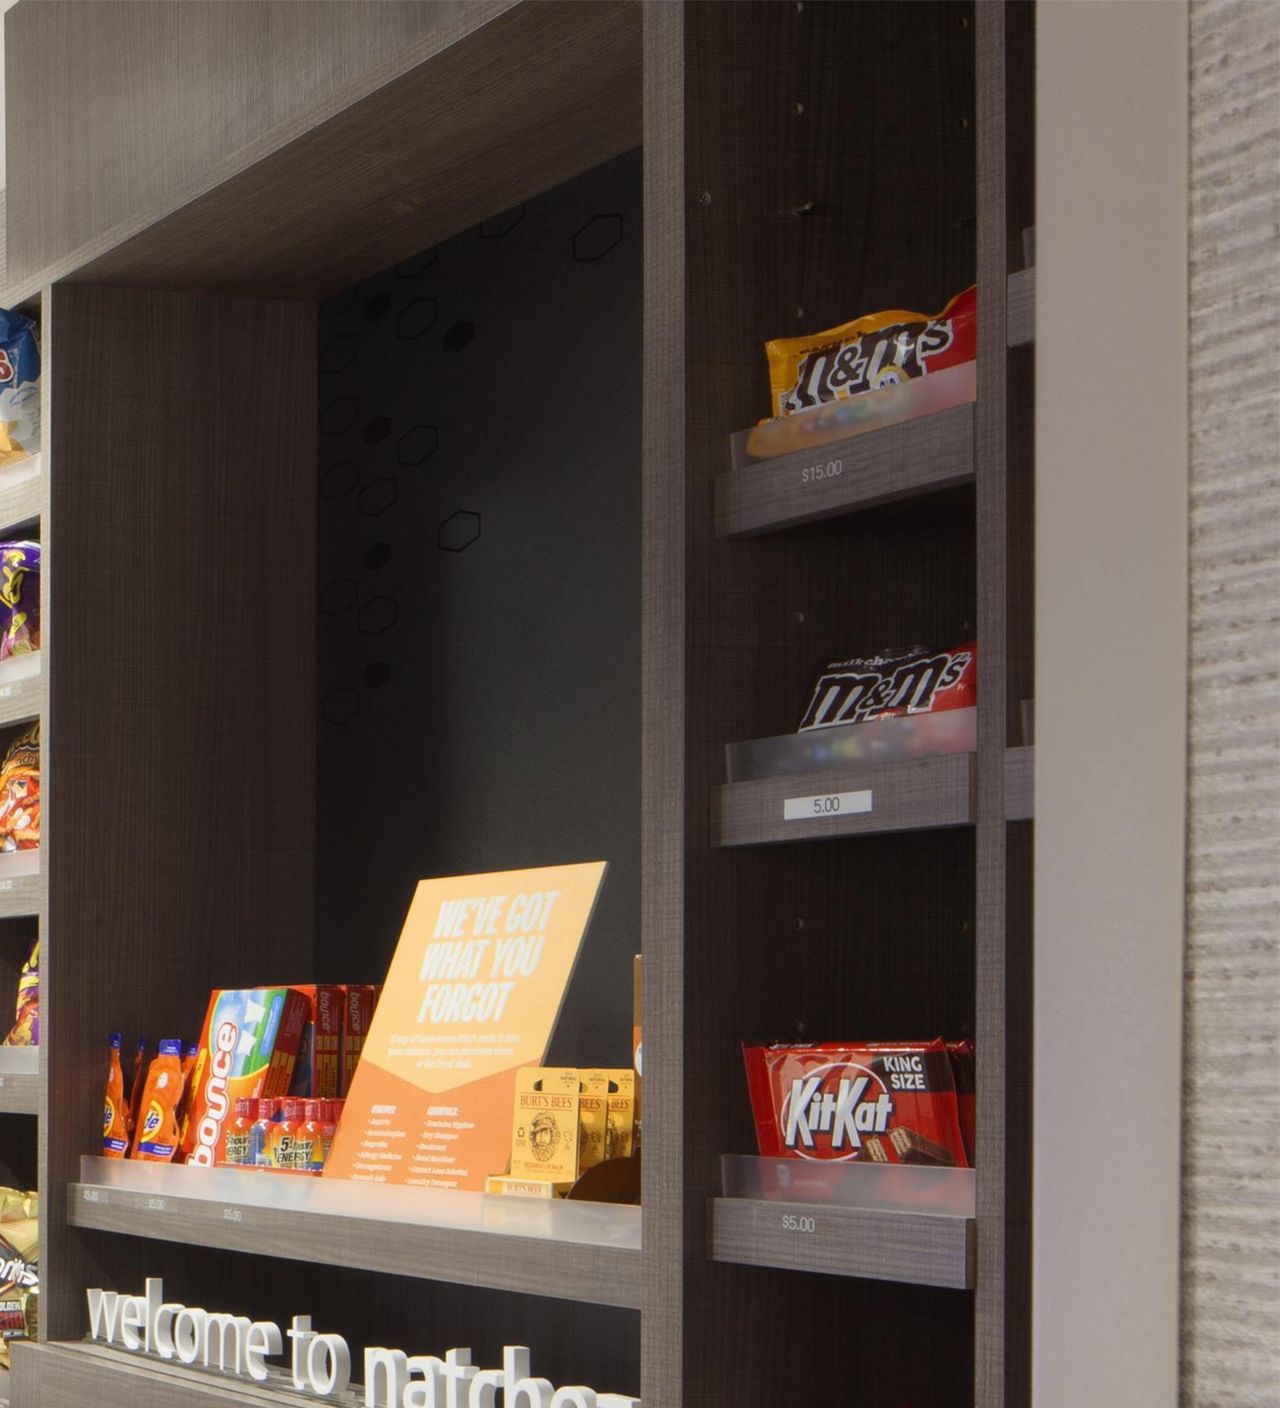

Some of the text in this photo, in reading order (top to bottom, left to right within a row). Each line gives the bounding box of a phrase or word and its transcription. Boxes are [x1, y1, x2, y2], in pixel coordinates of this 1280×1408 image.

[802, 460, 843, 482] $15.00
[814, 796, 840, 813] 5.00
[433, 889, 561, 939] WE'VE GOT
[419, 935, 545, 982] WHAT YOU
[416, 981, 515, 1024] FORGOT
[883, 1056, 923, 1072] KING
[891, 1074, 926, 1090] SIZE
[186, 1021, 238, 1167] bounce
[520, 1095, 573, 1109] BURT'S BEES
[611, 1098, 630, 1110] BEES
[277, 1151, 310, 1163] ENERGY
[782, 1215, 816, 1233] $5.00
[86, 1277, 283, 1381] welcome
[286, 1314, 353, 1396] to
